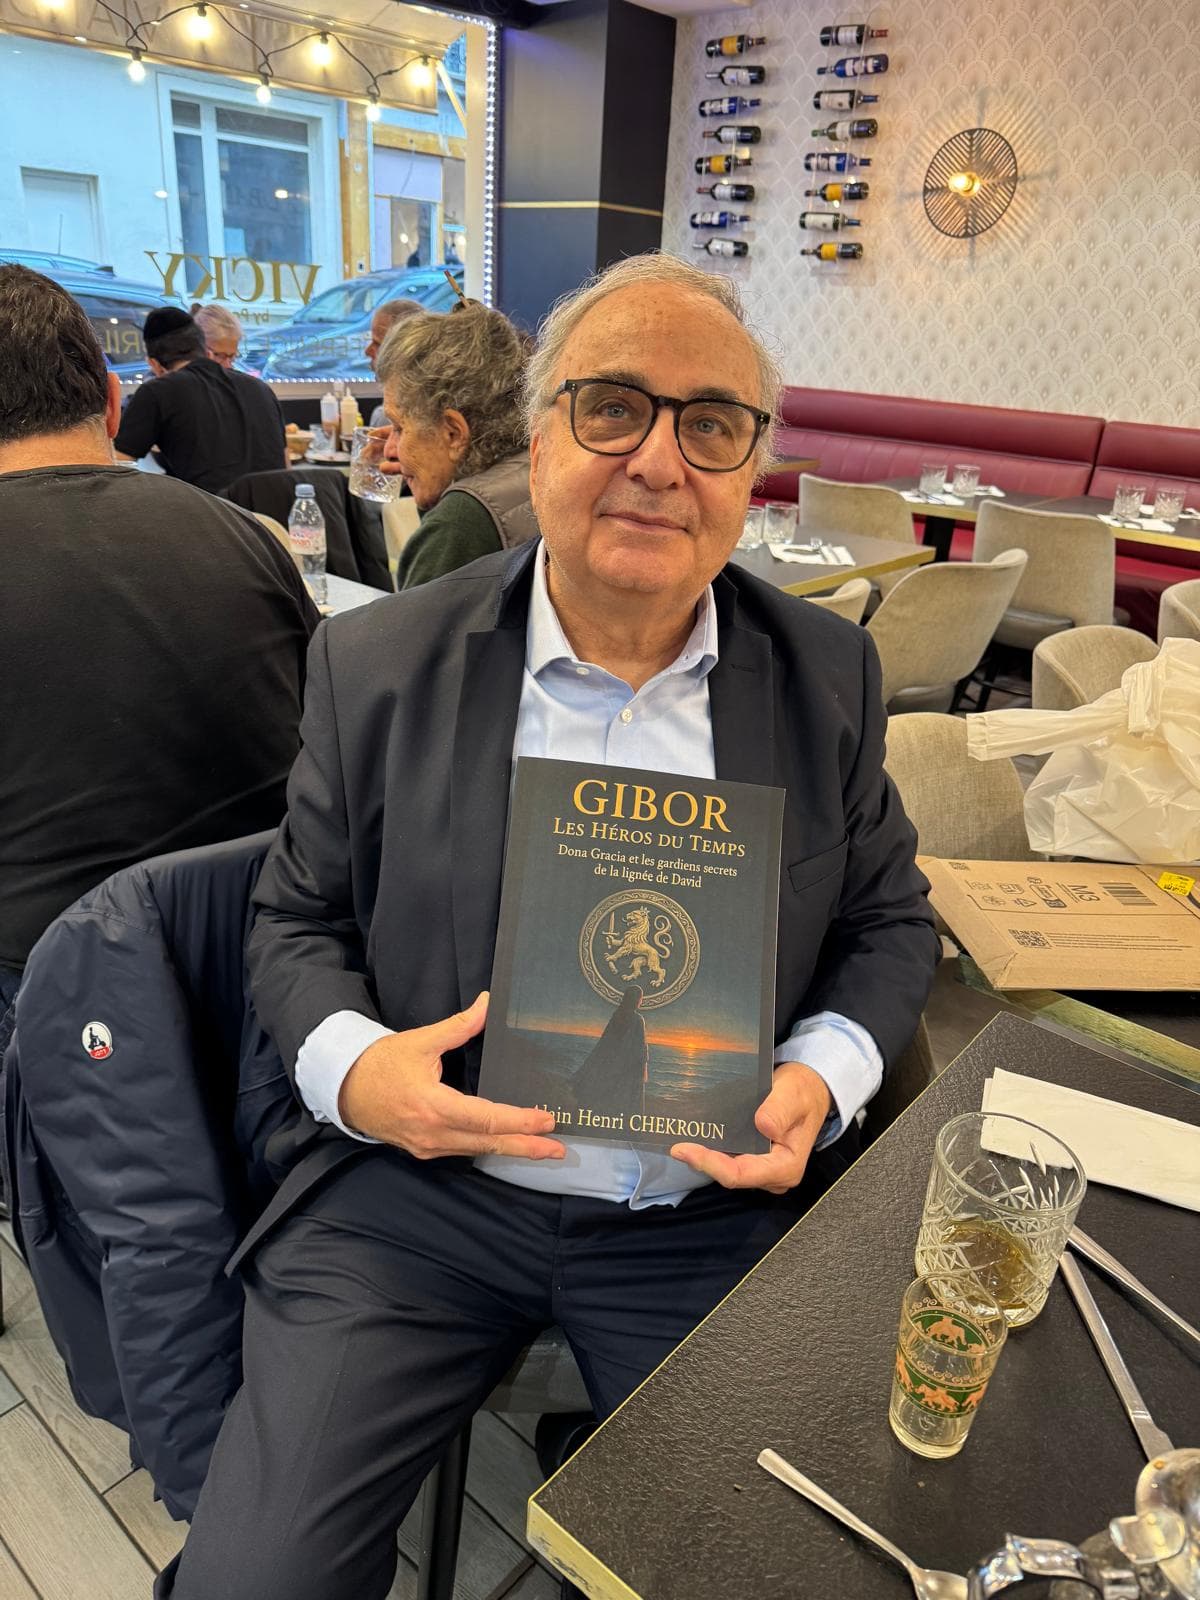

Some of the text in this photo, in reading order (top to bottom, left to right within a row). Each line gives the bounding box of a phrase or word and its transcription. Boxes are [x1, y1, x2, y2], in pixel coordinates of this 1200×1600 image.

[573, 779, 731, 833] GIBOR
[553, 817, 746, 857] LES HÉROS DU TEMPS
[558, 844, 738, 877] Dona Gracia et les gardiens secrets
[594, 864, 702, 888] de la lignée de David
[1068, 884, 1101, 902] M3
[533, 1104, 725, 1140] ain Henri CHEKROUN
